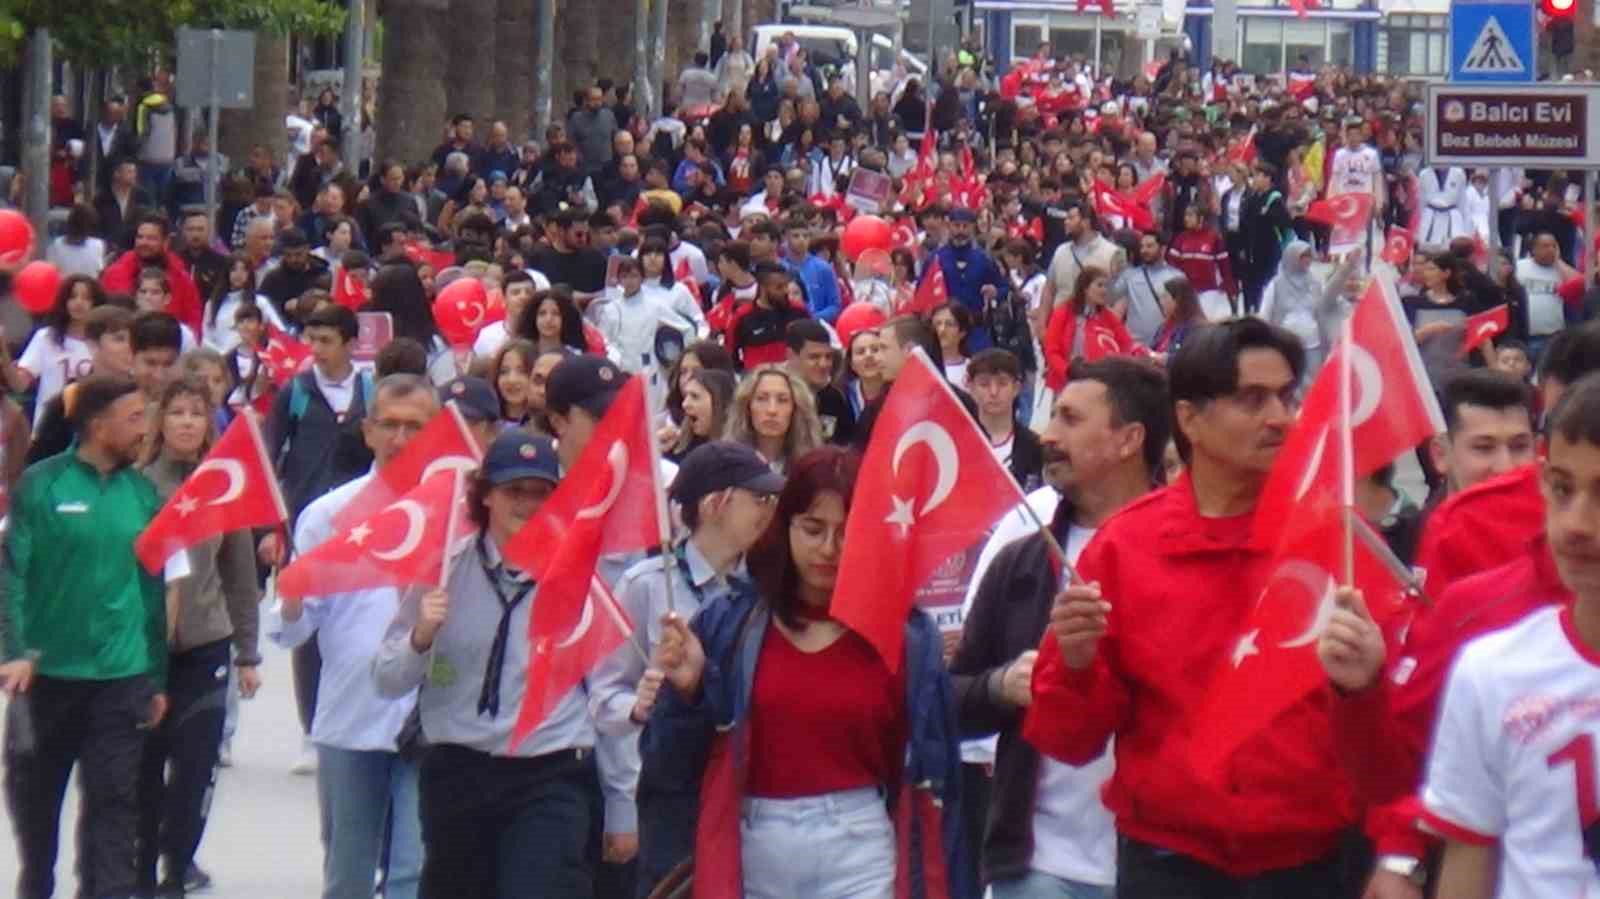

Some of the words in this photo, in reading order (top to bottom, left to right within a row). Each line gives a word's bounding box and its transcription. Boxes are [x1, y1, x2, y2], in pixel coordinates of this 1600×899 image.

[1470, 102, 1529, 122] Balcı
[1535, 102, 1572, 123] Evi
[1441, 132, 1470, 147] Bez
[1473, 133, 1521, 147] Bebek
[1525, 133, 1578, 148] Müzesi
